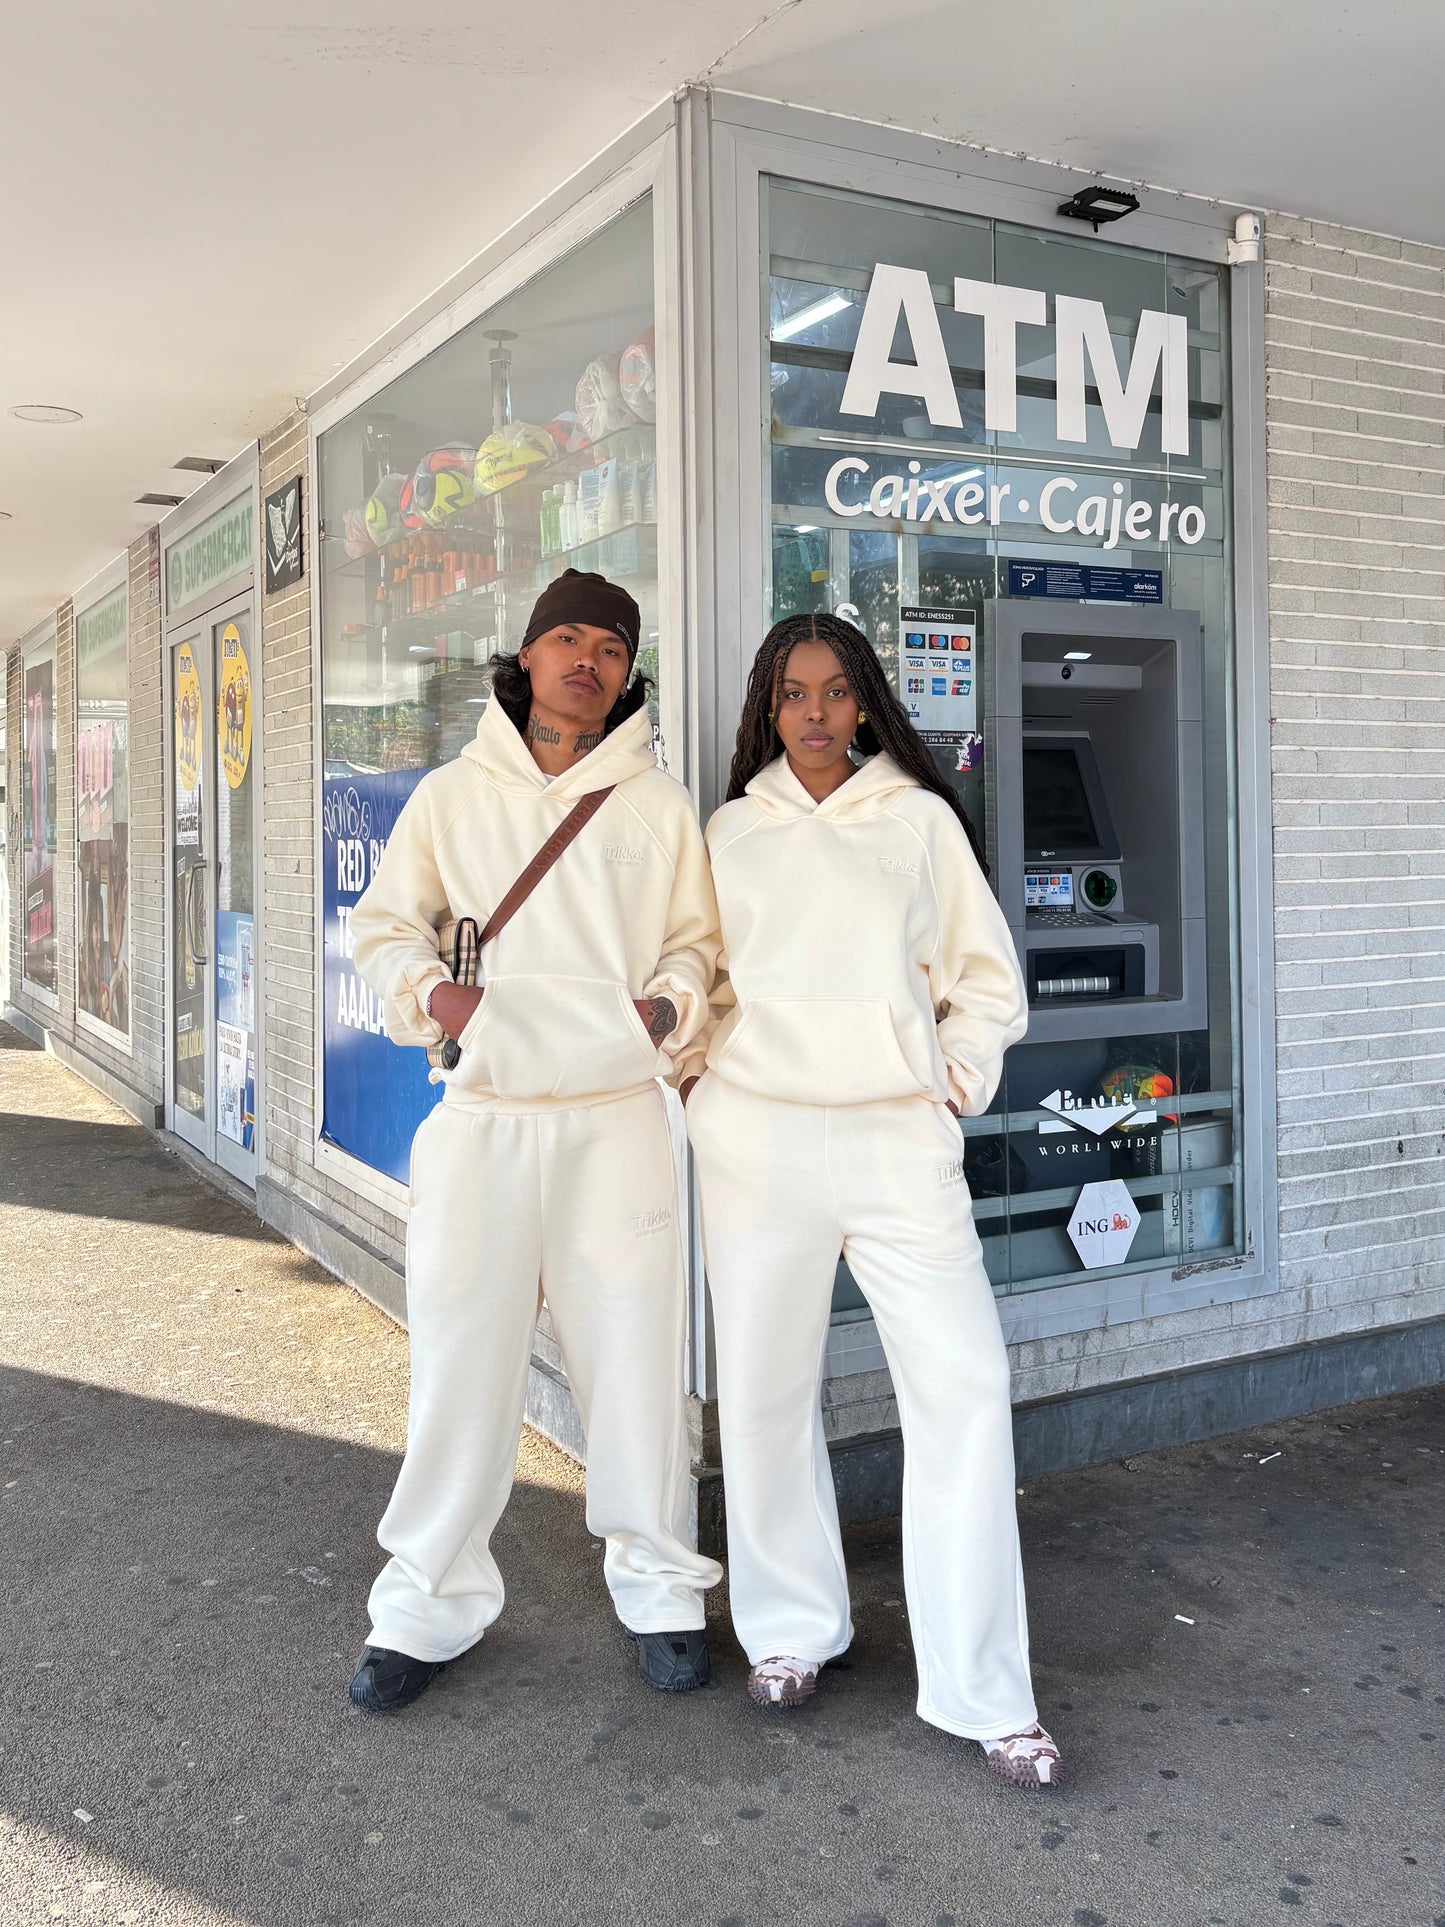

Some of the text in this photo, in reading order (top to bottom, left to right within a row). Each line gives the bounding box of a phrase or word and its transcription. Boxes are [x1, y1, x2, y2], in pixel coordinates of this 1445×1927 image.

[839, 263, 1189, 455] ATM
[824, 457, 1206, 549] Caixer Cajero
[185, 506, 252, 592] SUPERMERCAT
[909, 660, 924, 668] VISA
[911, 703, 917, 711] V
[534, 793, 601, 872] URBERRY
[337, 839, 365, 892] RED
[337, 972, 388, 1038] AAALA
[1077, 1218, 1109, 1236] ING
[1187, 1208, 1195, 1233] Digital
